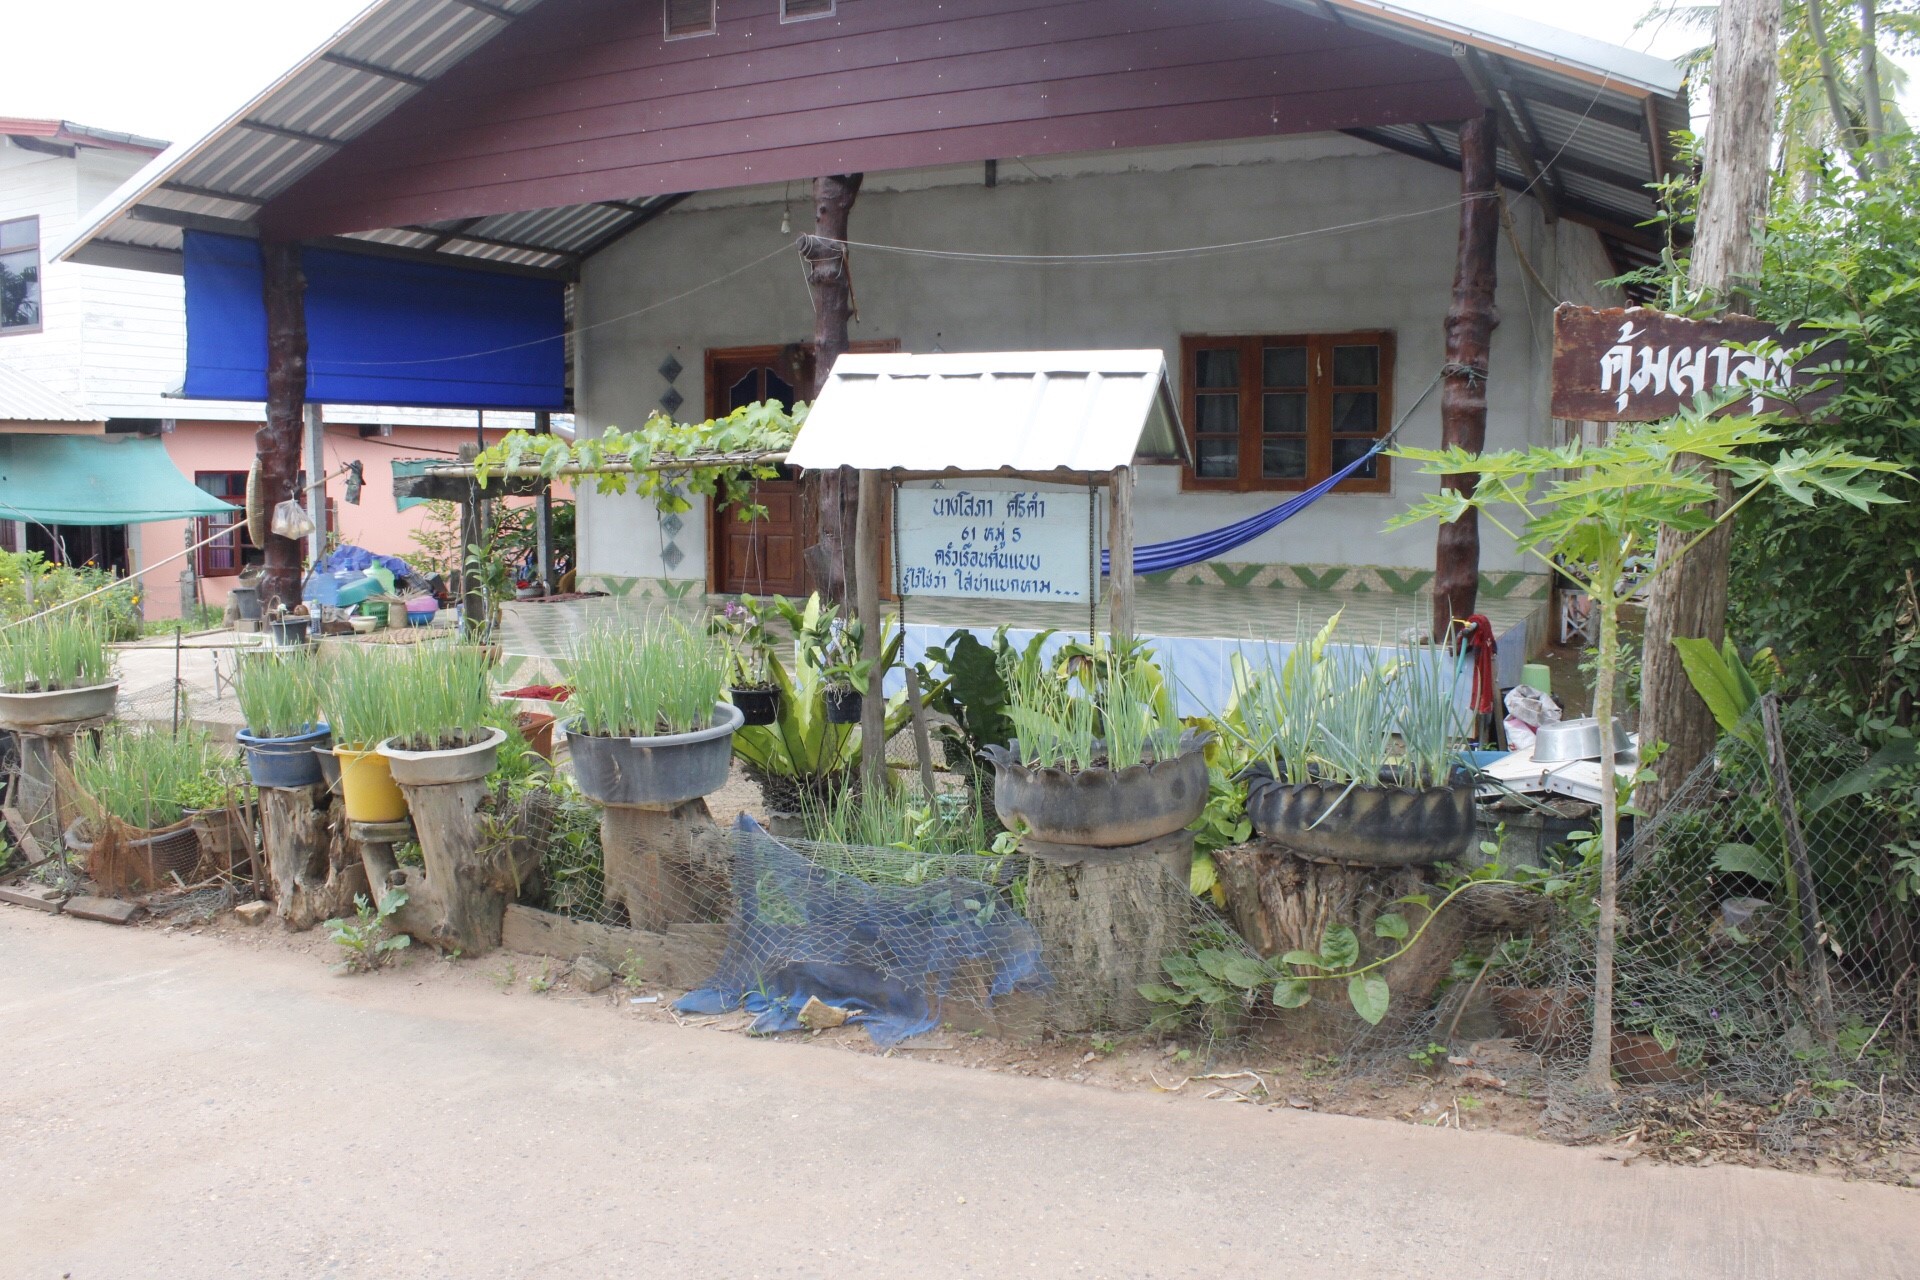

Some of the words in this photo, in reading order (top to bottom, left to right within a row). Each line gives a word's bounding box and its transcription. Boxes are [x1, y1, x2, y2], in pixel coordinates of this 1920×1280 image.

[933, 491, 993, 518] นางโสภา
[962, 526, 976, 541] 61
[984, 521, 1006, 549] หมู่
[1012, 527, 1022, 543] 5
[935, 541, 1041, 571] ครัวเรือนต้นแบบ
[902, 566, 947, 594] รู้ไว้ใช่ว่า
